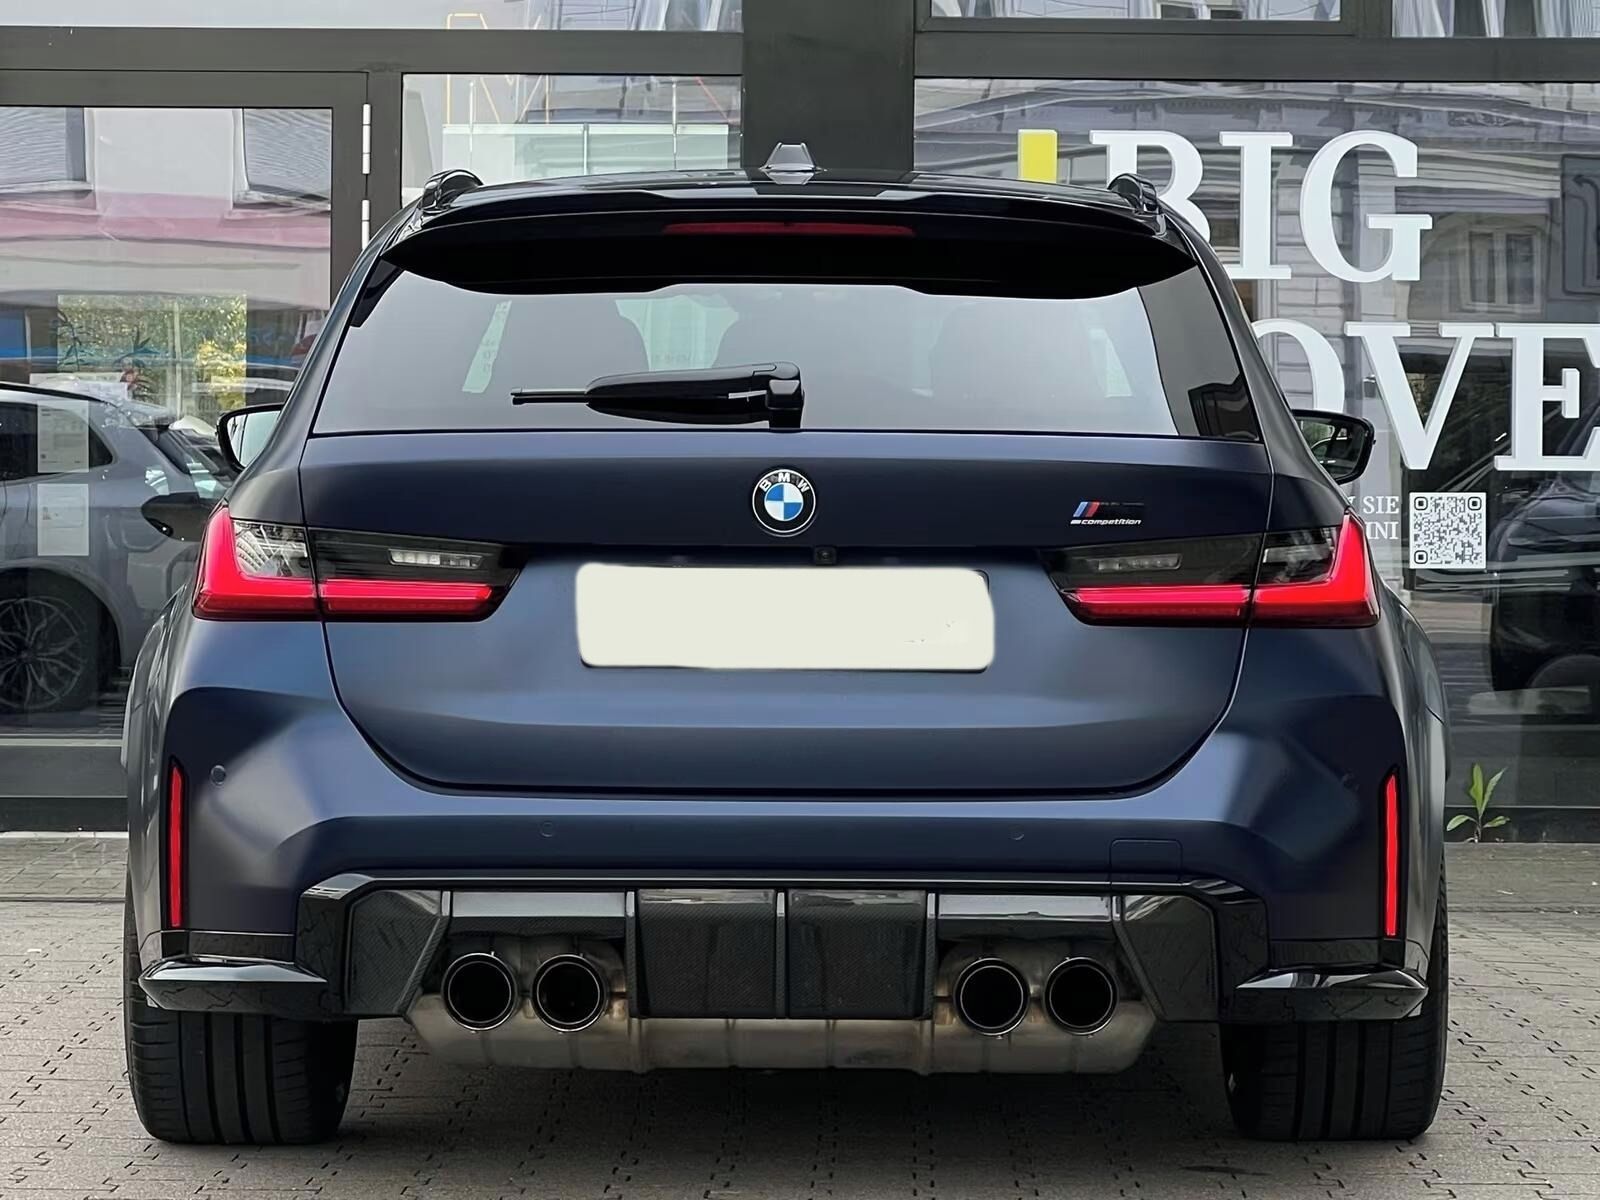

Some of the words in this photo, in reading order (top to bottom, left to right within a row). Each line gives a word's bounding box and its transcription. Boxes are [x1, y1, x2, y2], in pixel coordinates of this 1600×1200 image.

[1089, 129, 1433, 283] BIG
[758, 471, 810, 493] BMW
[1362, 495, 1400, 514] SIE
[1080, 518, 1142, 526] competition
